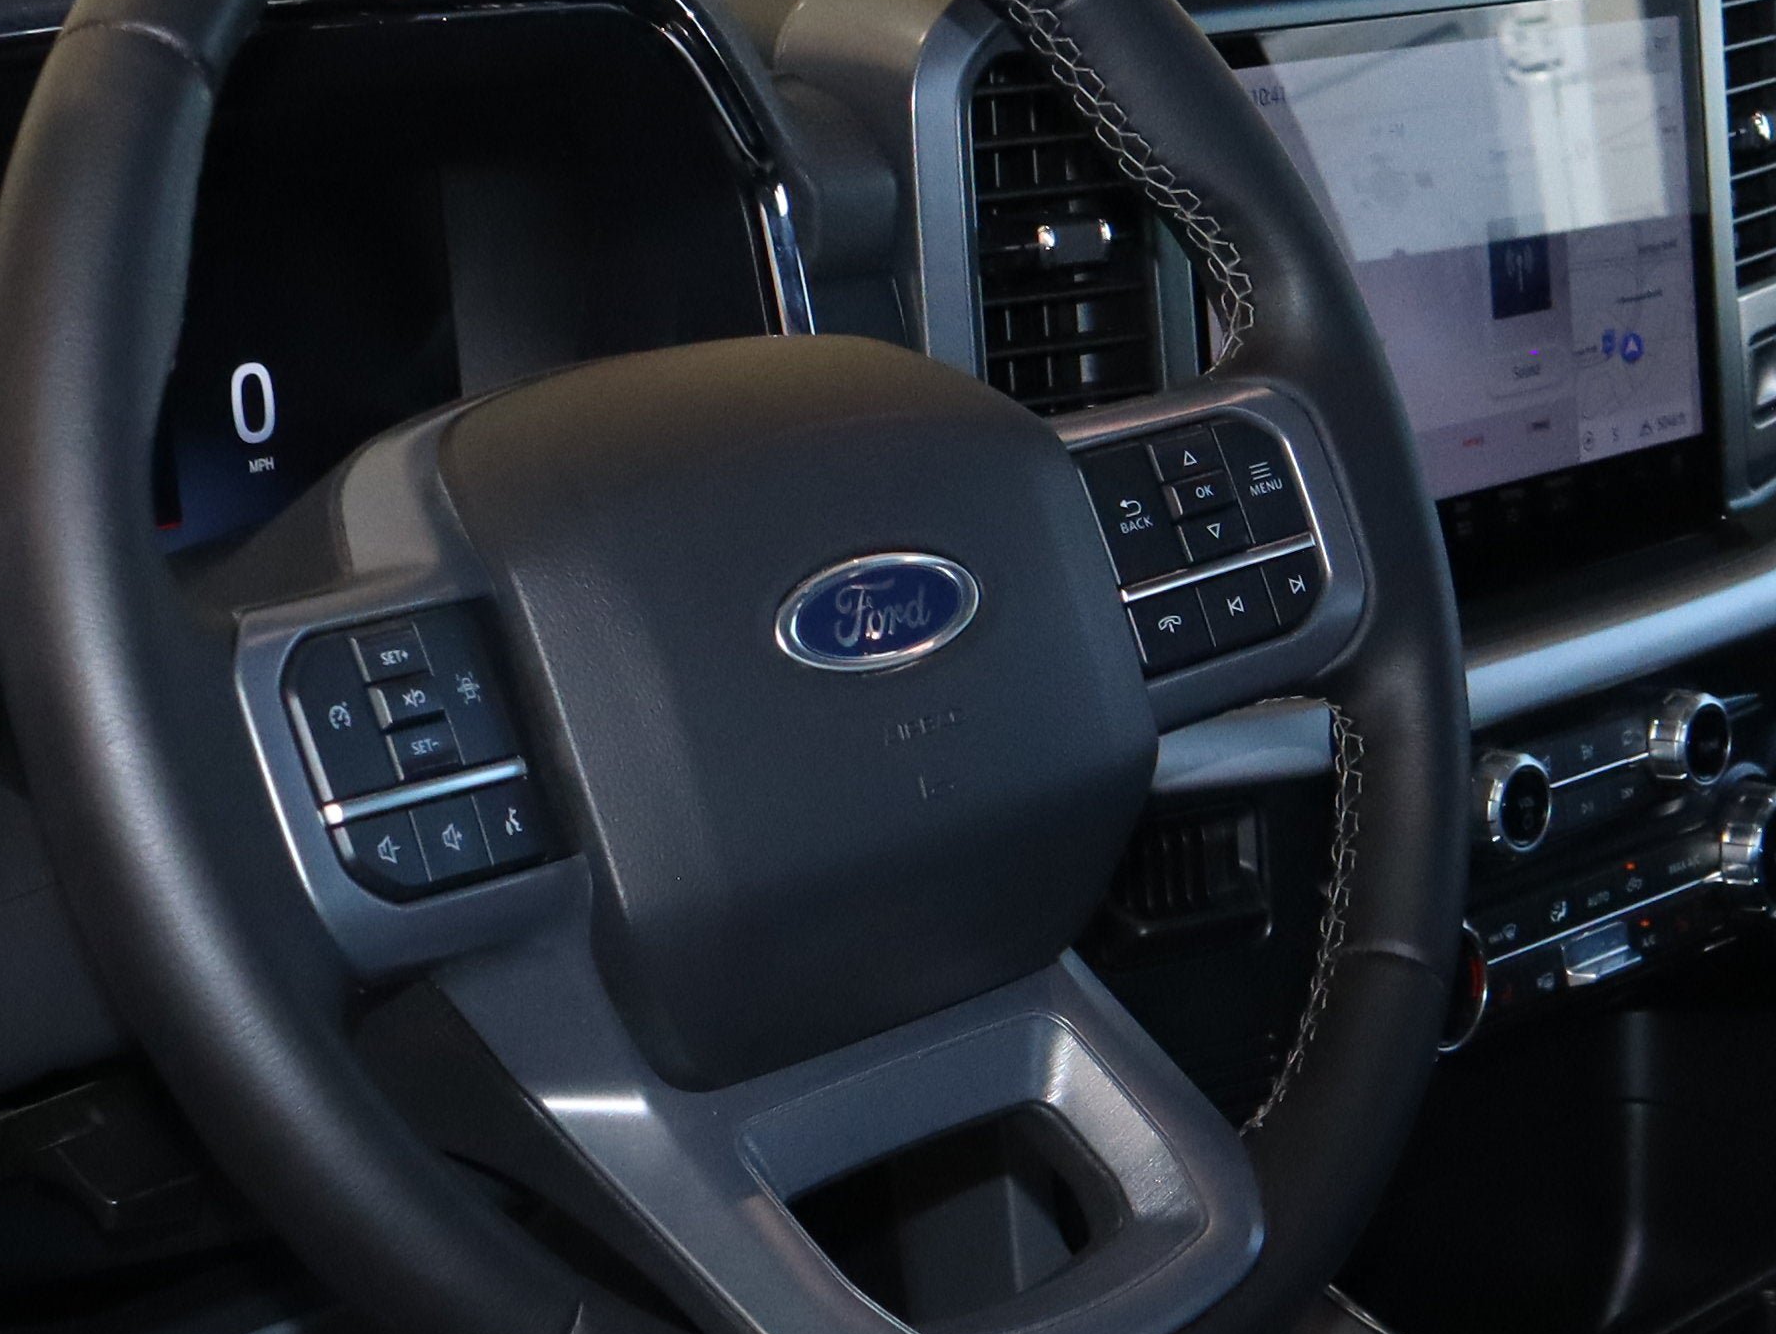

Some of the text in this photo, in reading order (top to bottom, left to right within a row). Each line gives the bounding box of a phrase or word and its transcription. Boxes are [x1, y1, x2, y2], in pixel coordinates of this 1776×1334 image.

[231, 361, 275, 444] 0
[248, 456, 275, 474] MPH
[1195, 485, 1215, 499] OK
[1248, 478, 1284, 498] MENU
[1119, 515, 1155, 535] BACK
[835, 579, 932, 648] Ford
